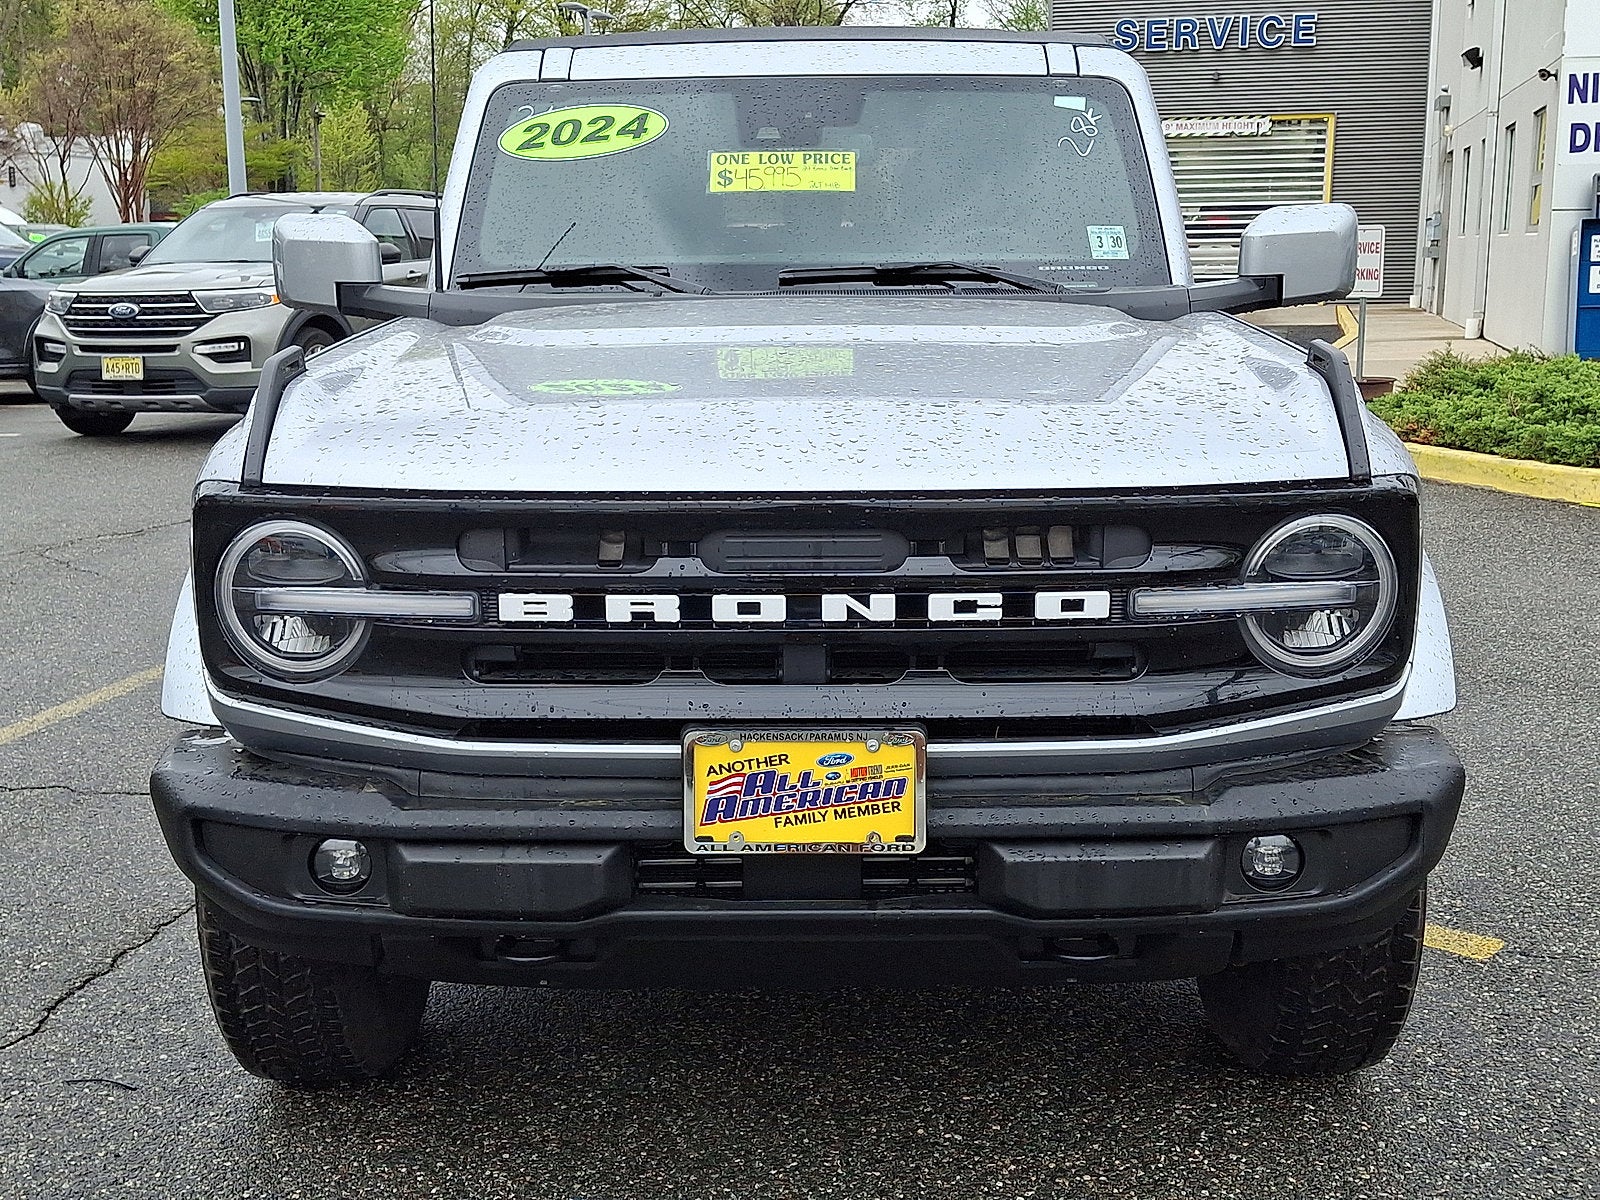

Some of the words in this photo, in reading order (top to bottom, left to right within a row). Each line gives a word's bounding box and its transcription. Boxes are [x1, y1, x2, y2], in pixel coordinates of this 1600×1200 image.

[1113, 13, 1319, 51] SERVICE
[516, 113, 650, 152] 2024
[1175, 123, 1219, 131] MAXIMUM
[1221, 122, 1255, 130] HEIGHT
[716, 154, 750, 166] ONE
[758, 153, 794, 165] LOW
[802, 153, 851, 165] PRICE
[1096, 235, 1104, 249] 3
[1109, 235, 1123, 249] 30
[1358, 241, 1380, 254] RVICE
[1356, 267, 1379, 281] RKING
[499, 591, 1111, 622] BRONCO
[856, 732, 870, 741] NJ
[706, 754, 790, 777] ANOTHER
[821, 754, 850, 766] Ford
[774, 810, 829, 828] FAMILY
[834, 801, 902, 820] MEMBER
[696, 844, 734, 852] ALL
[740, 843, 851, 852] AMERICAN
[861, 843, 915, 852] FORD
